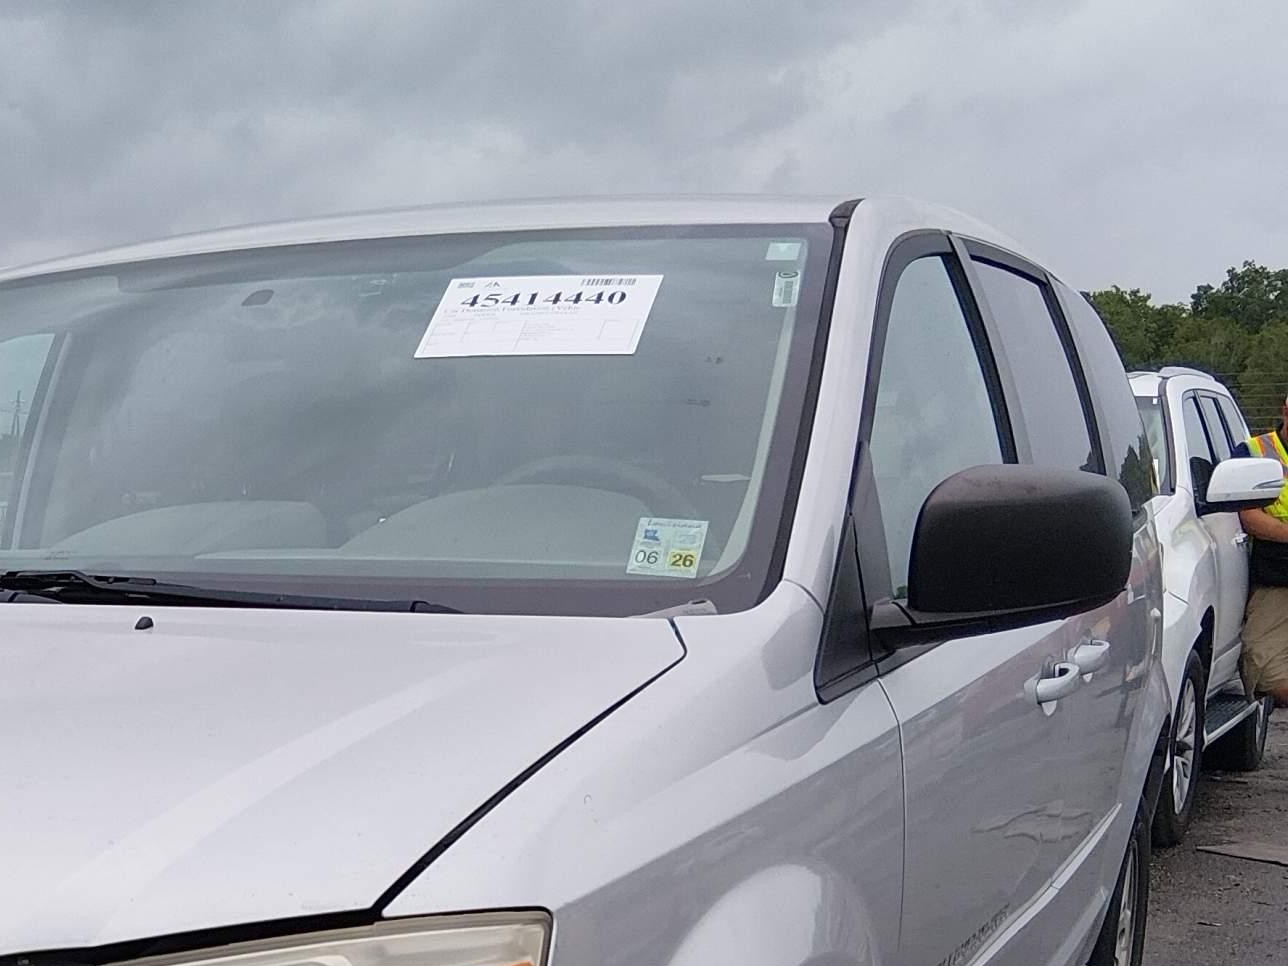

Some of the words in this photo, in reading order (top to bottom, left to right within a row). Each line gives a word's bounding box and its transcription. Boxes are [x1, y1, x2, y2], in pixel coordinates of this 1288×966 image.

[460, 290, 628, 309] 45414440
[634, 549, 659, 565] 06
[670, 552, 695, 568] 26
